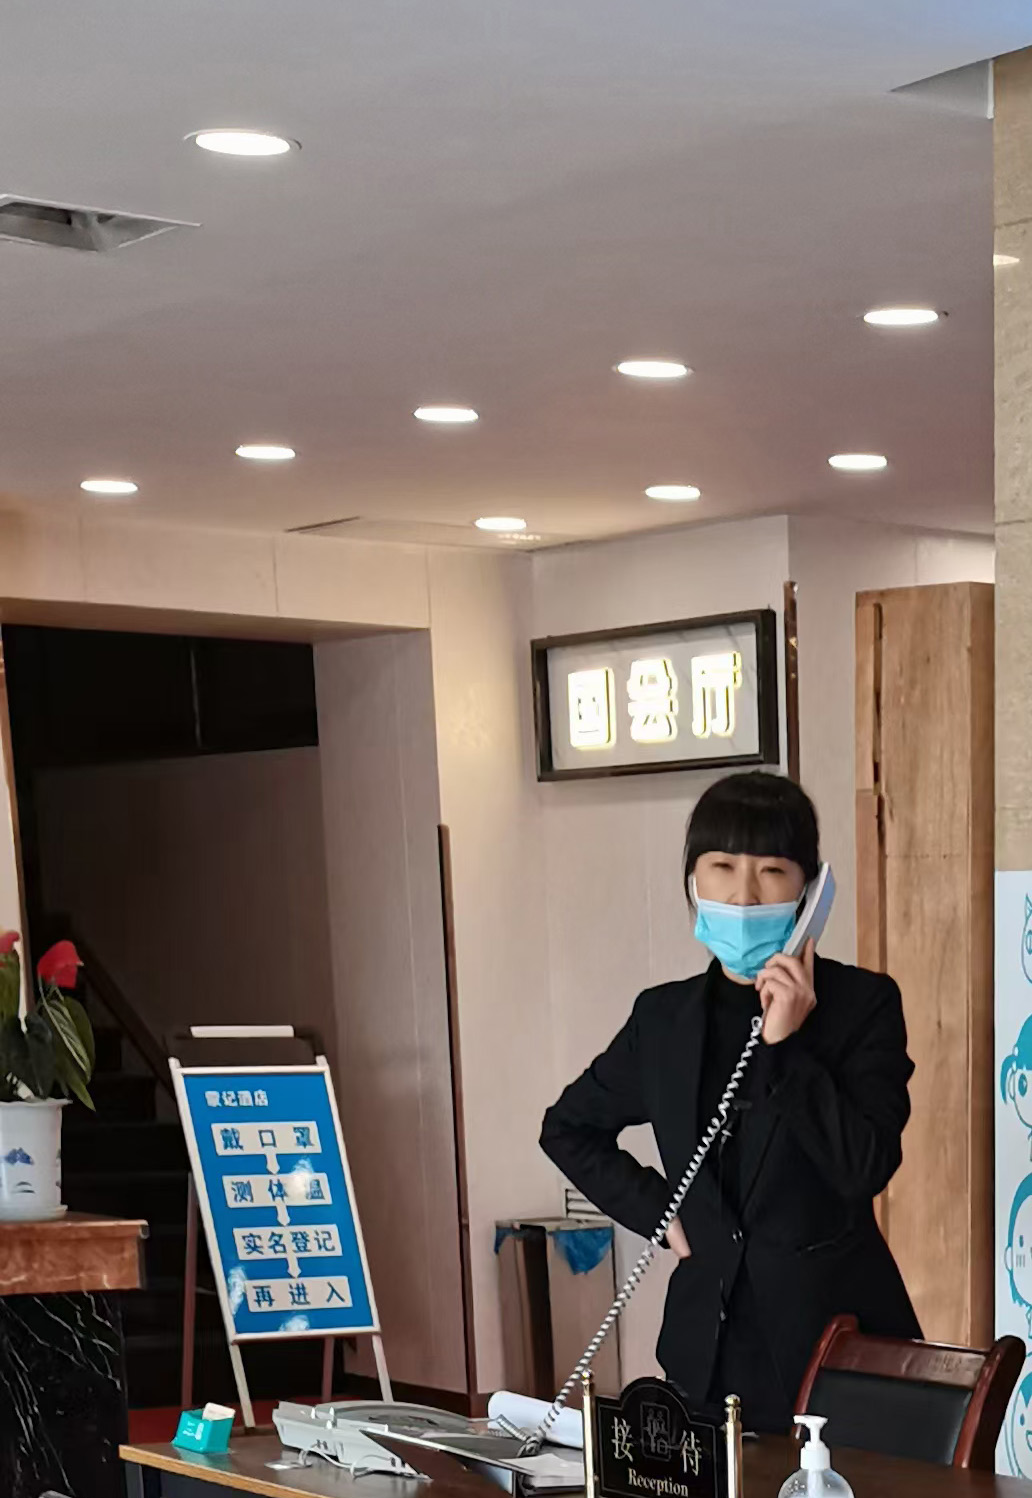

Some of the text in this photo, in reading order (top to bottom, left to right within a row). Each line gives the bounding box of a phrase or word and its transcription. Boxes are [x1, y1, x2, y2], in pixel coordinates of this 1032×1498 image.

[220, 1126, 314, 1150] 戴口罩
[242, 1230, 335, 1255] 实名登记
[253, 1283, 346, 1308] 再进入
[628, 1468, 689, 1498] Reception
